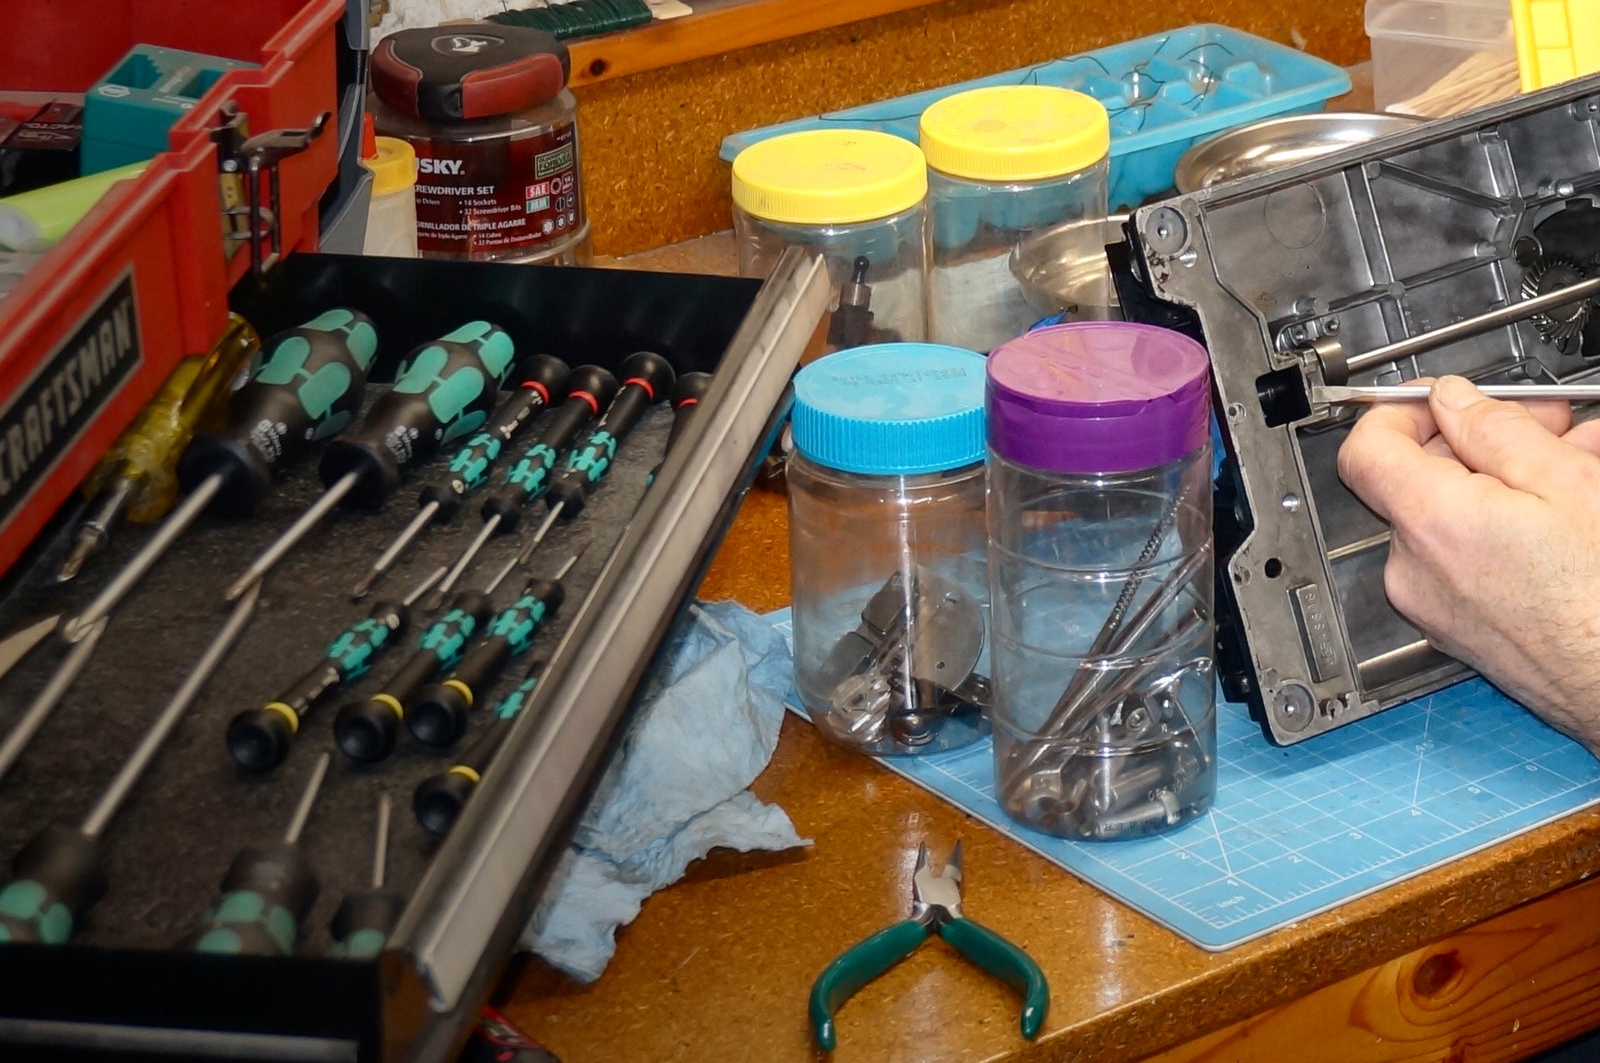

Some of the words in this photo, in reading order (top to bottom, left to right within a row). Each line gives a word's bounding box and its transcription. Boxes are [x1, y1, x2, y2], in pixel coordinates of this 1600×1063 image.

[416, 185, 475, 196] REWDRIVER
[476, 185, 495, 195] SET
[529, 183, 546, 197] SAE
[530, 200, 547, 212] MM
[0, 296, 132, 495] CRAFTSMAN
